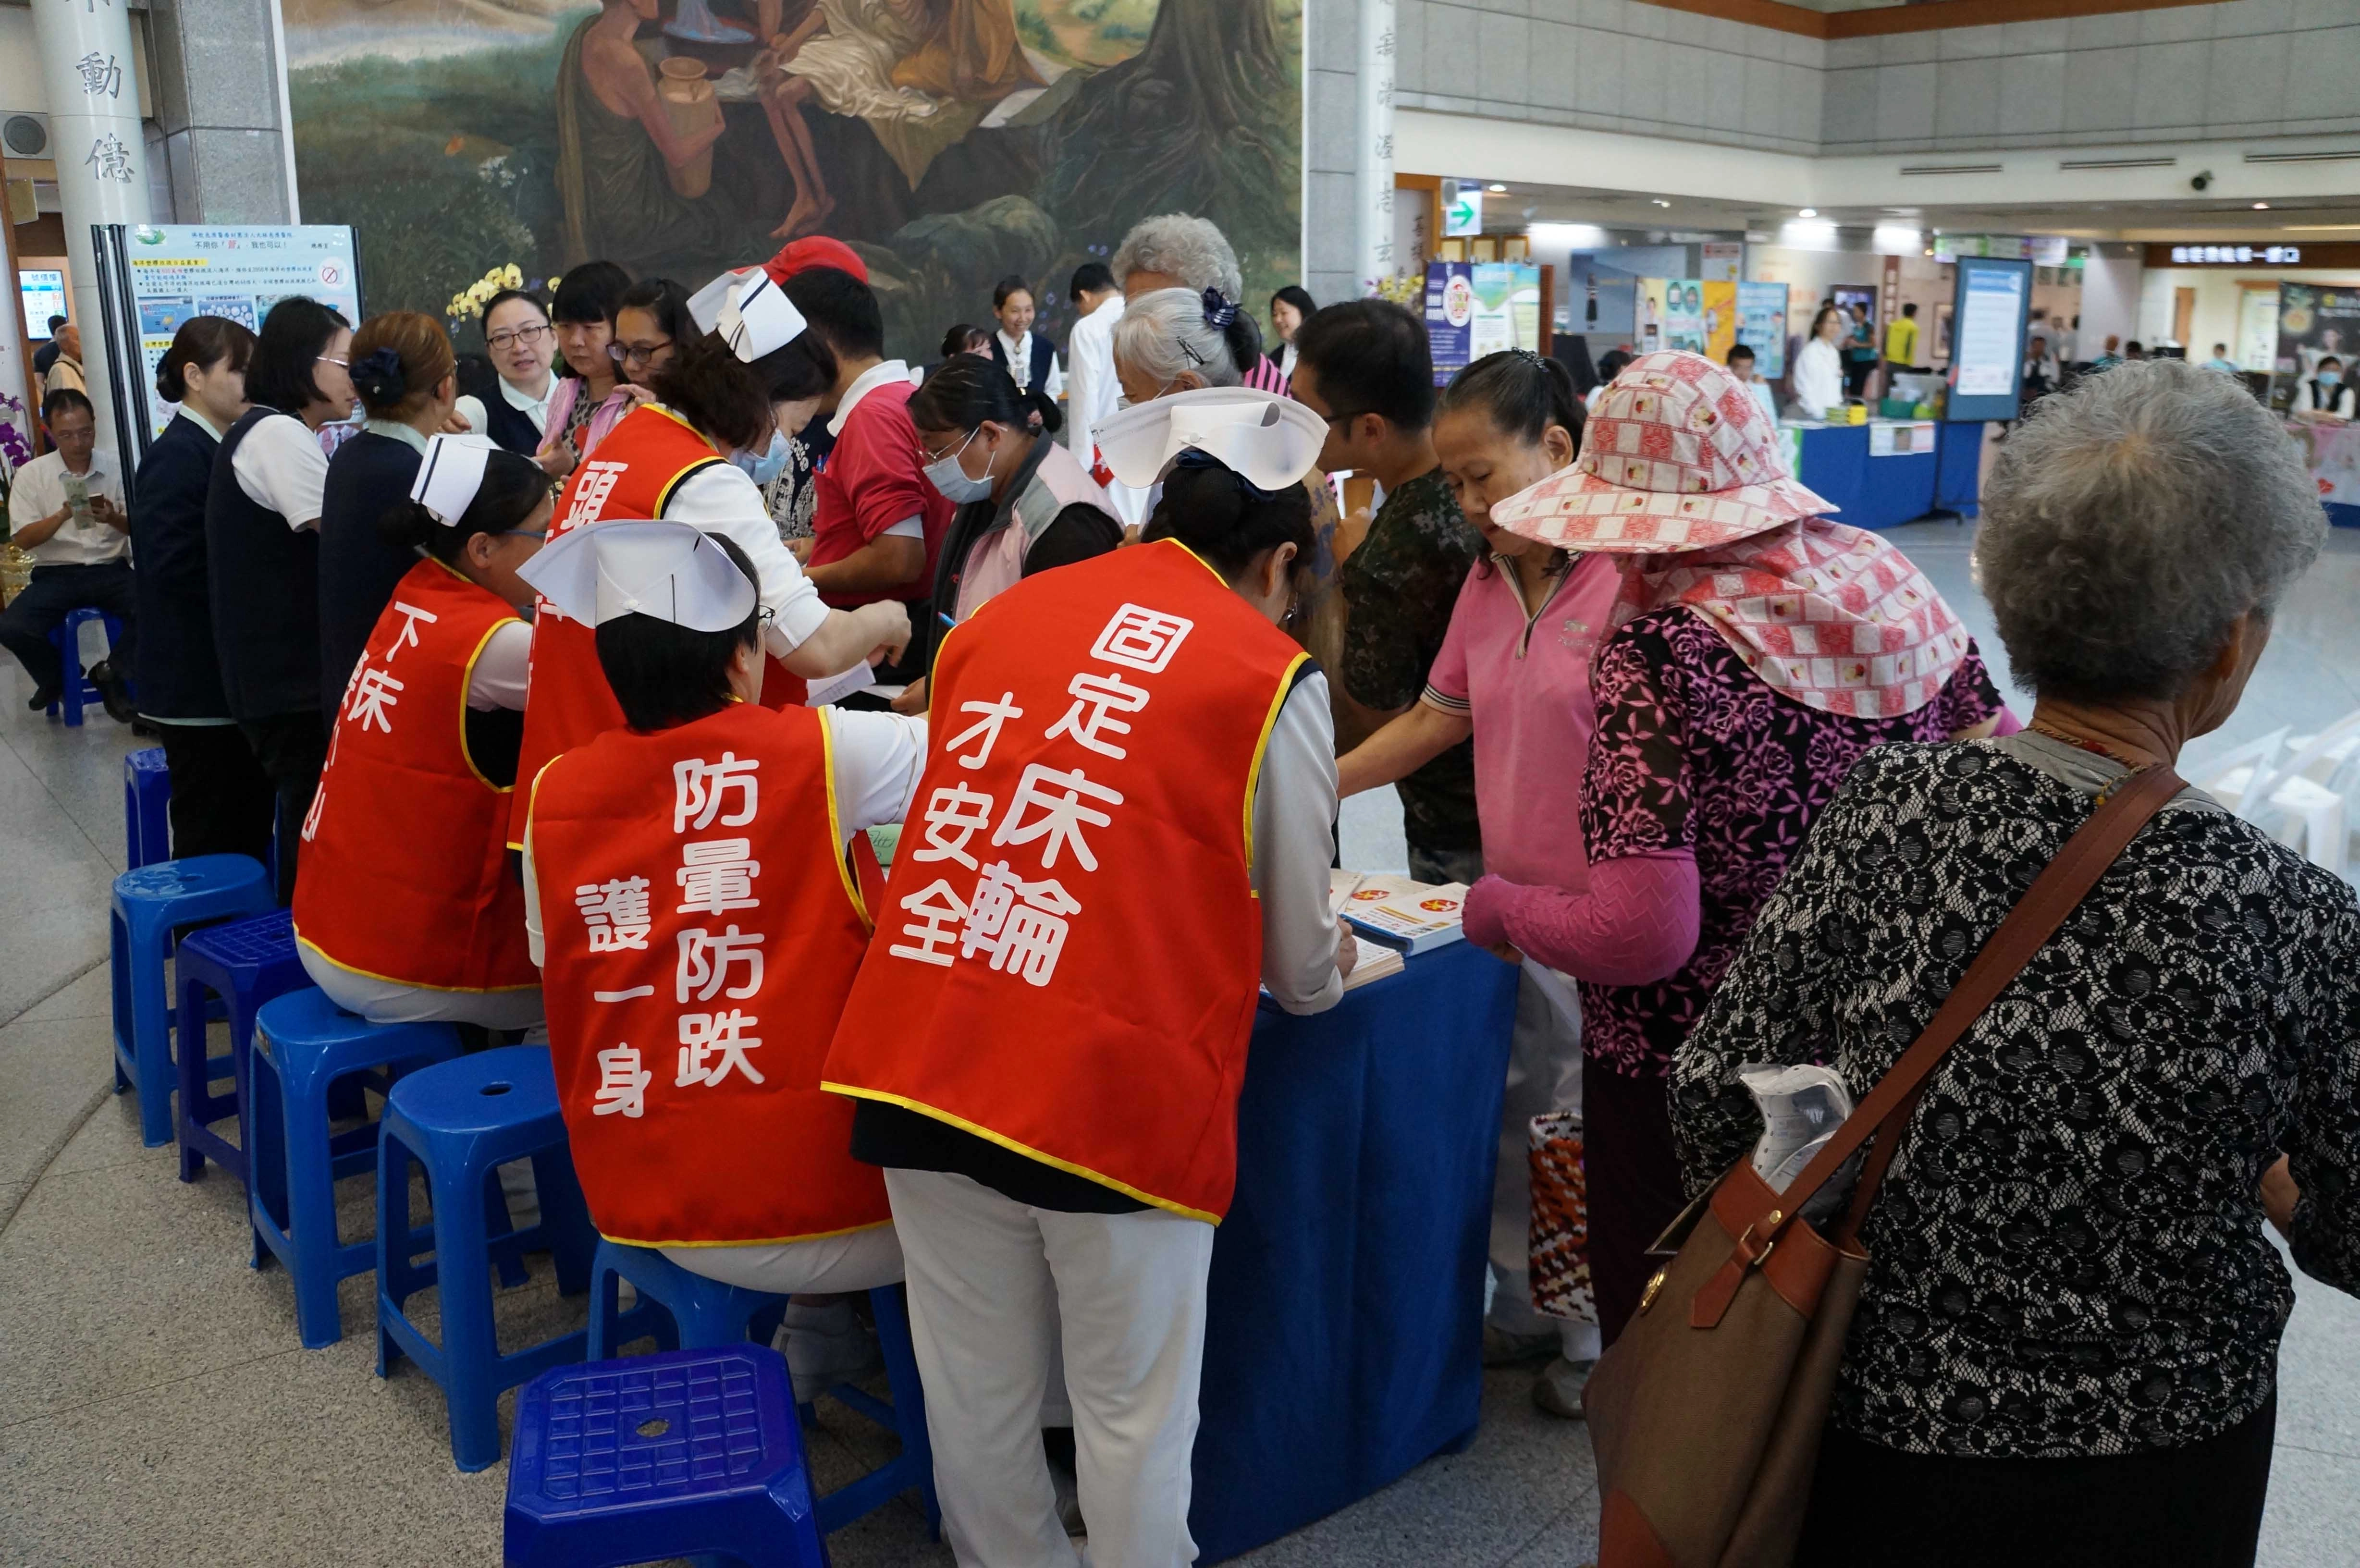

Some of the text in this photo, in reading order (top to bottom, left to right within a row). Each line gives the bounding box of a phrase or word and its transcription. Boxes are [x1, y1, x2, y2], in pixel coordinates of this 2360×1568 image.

[347, 600, 438, 733] 下床
[961, 603, 1194, 987] 固定床輪
[674, 752, 765, 1087] 防暈防跌
[889, 691, 1023, 967] 才安全
[575, 875, 654, 1118] 護一身
